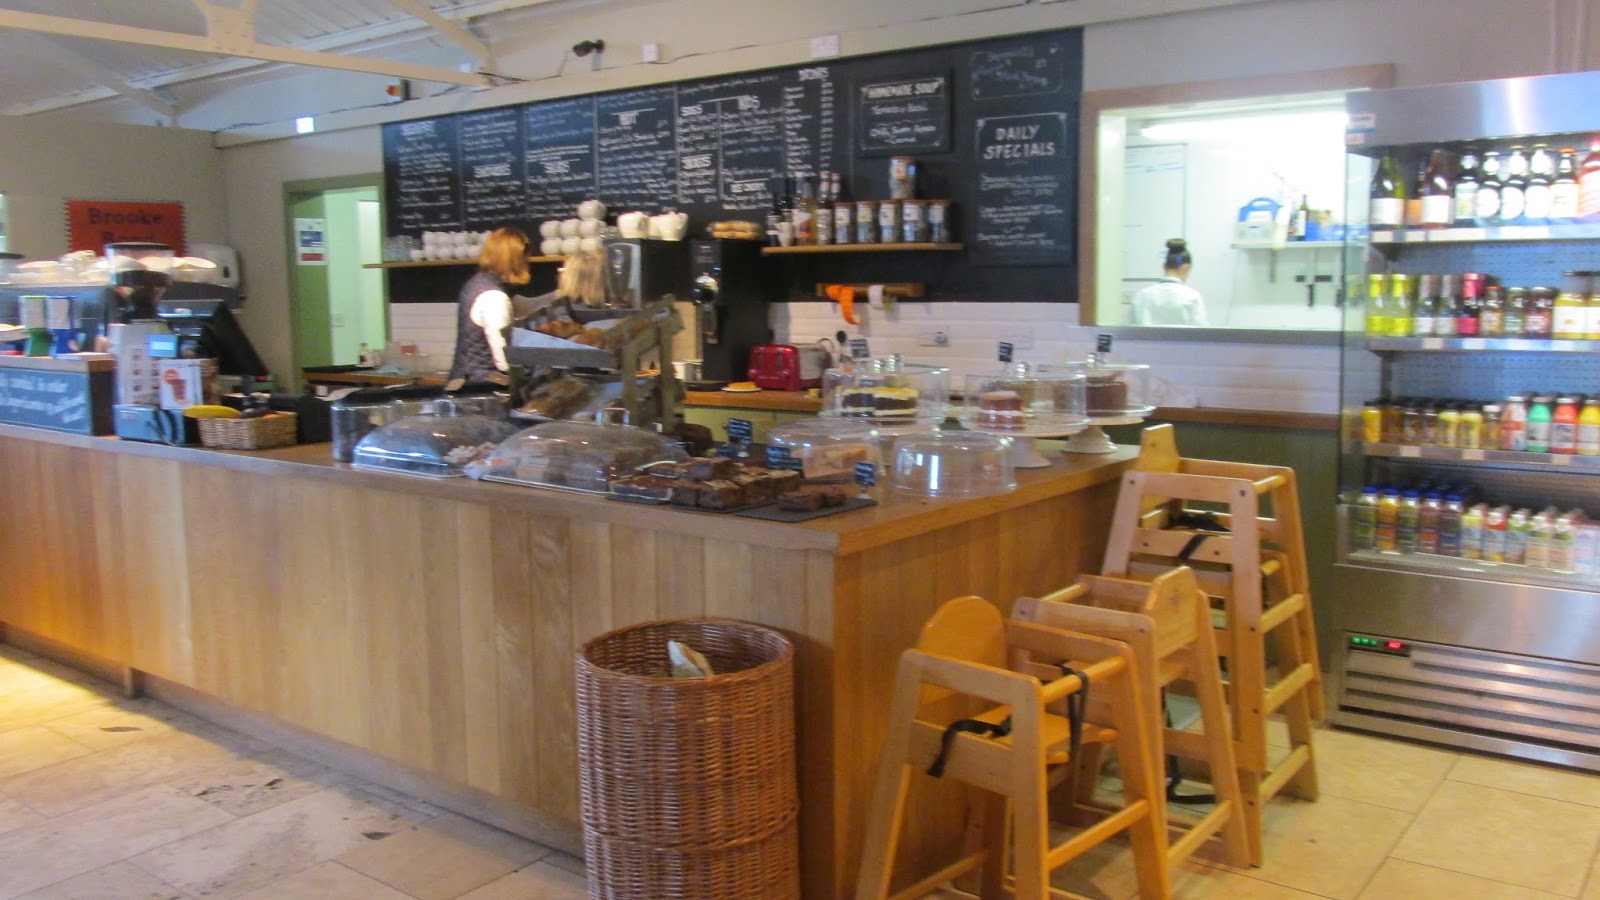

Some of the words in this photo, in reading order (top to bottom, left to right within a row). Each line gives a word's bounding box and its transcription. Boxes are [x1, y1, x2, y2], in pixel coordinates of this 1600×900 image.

[995, 124, 1041, 141] DAILY
[982, 141, 1056, 160] SPECIALS
[88, 208, 162, 225] Brooke
